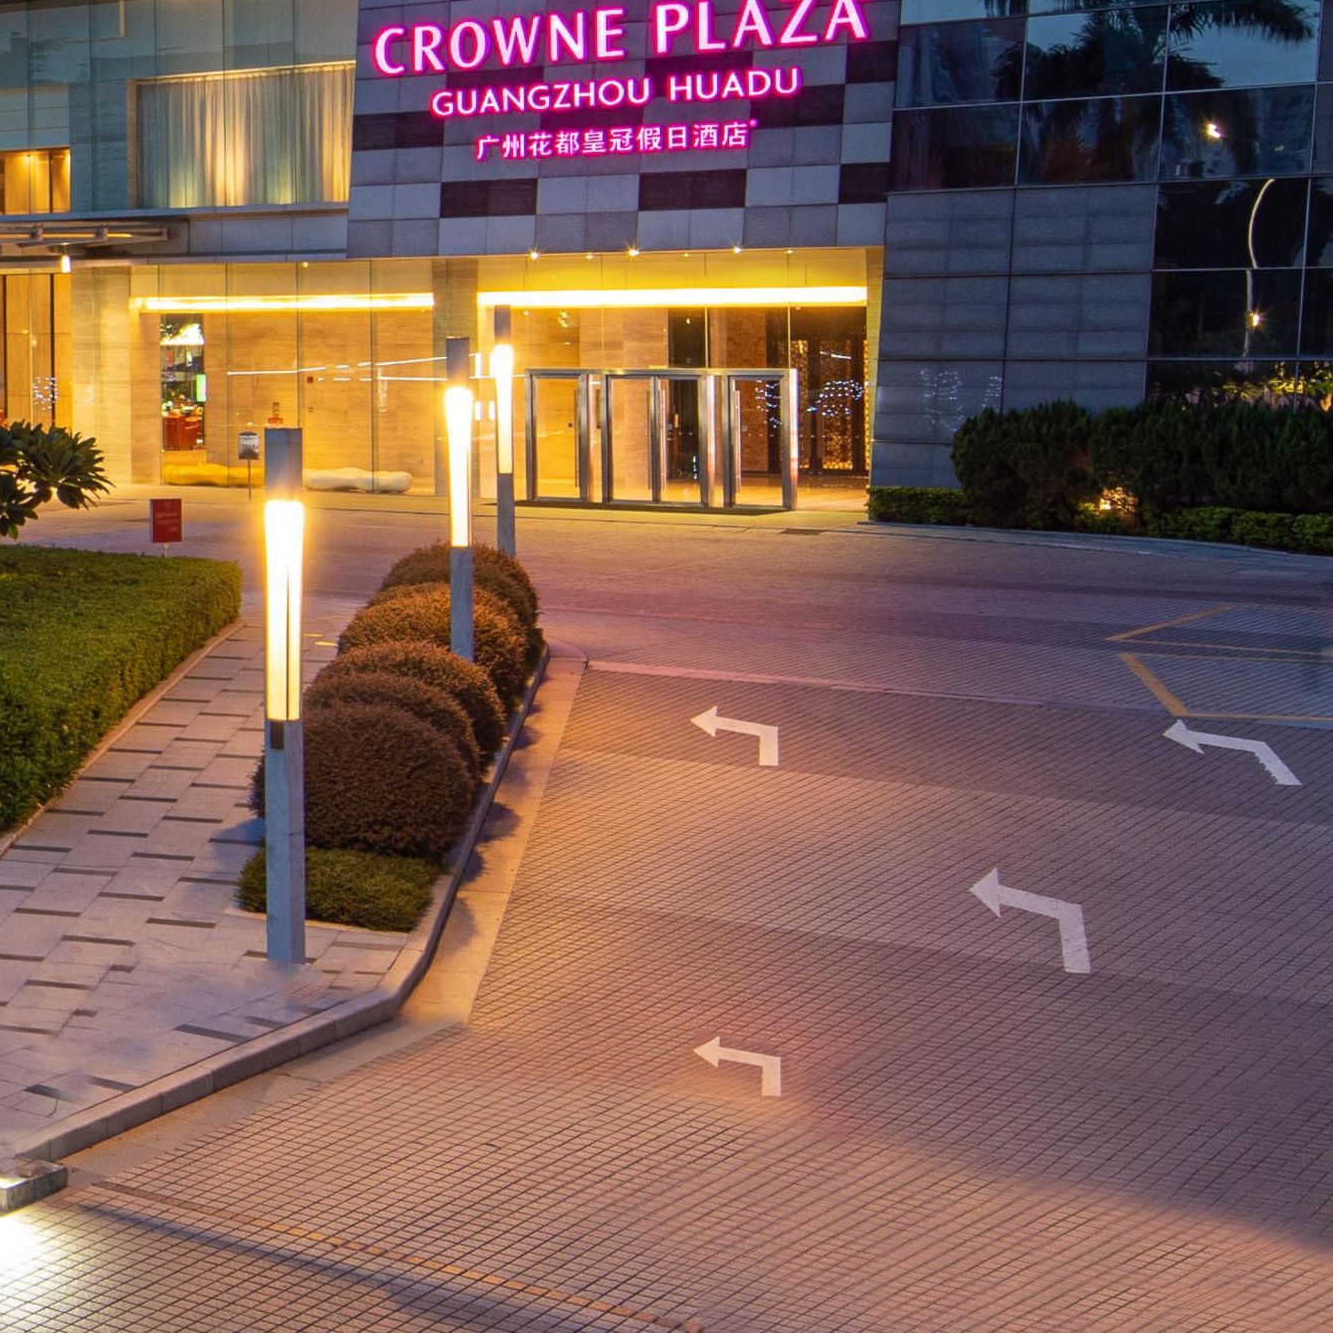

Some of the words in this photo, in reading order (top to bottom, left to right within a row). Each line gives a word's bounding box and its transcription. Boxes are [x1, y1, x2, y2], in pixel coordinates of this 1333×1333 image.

[374, 8, 625, 75] CROWNE
[432, 77, 651, 117] GUANGZHOU
[669, 67, 799, 102] HUADU
[476, 122, 749, 161] 广州花都皇冠假日酒店
